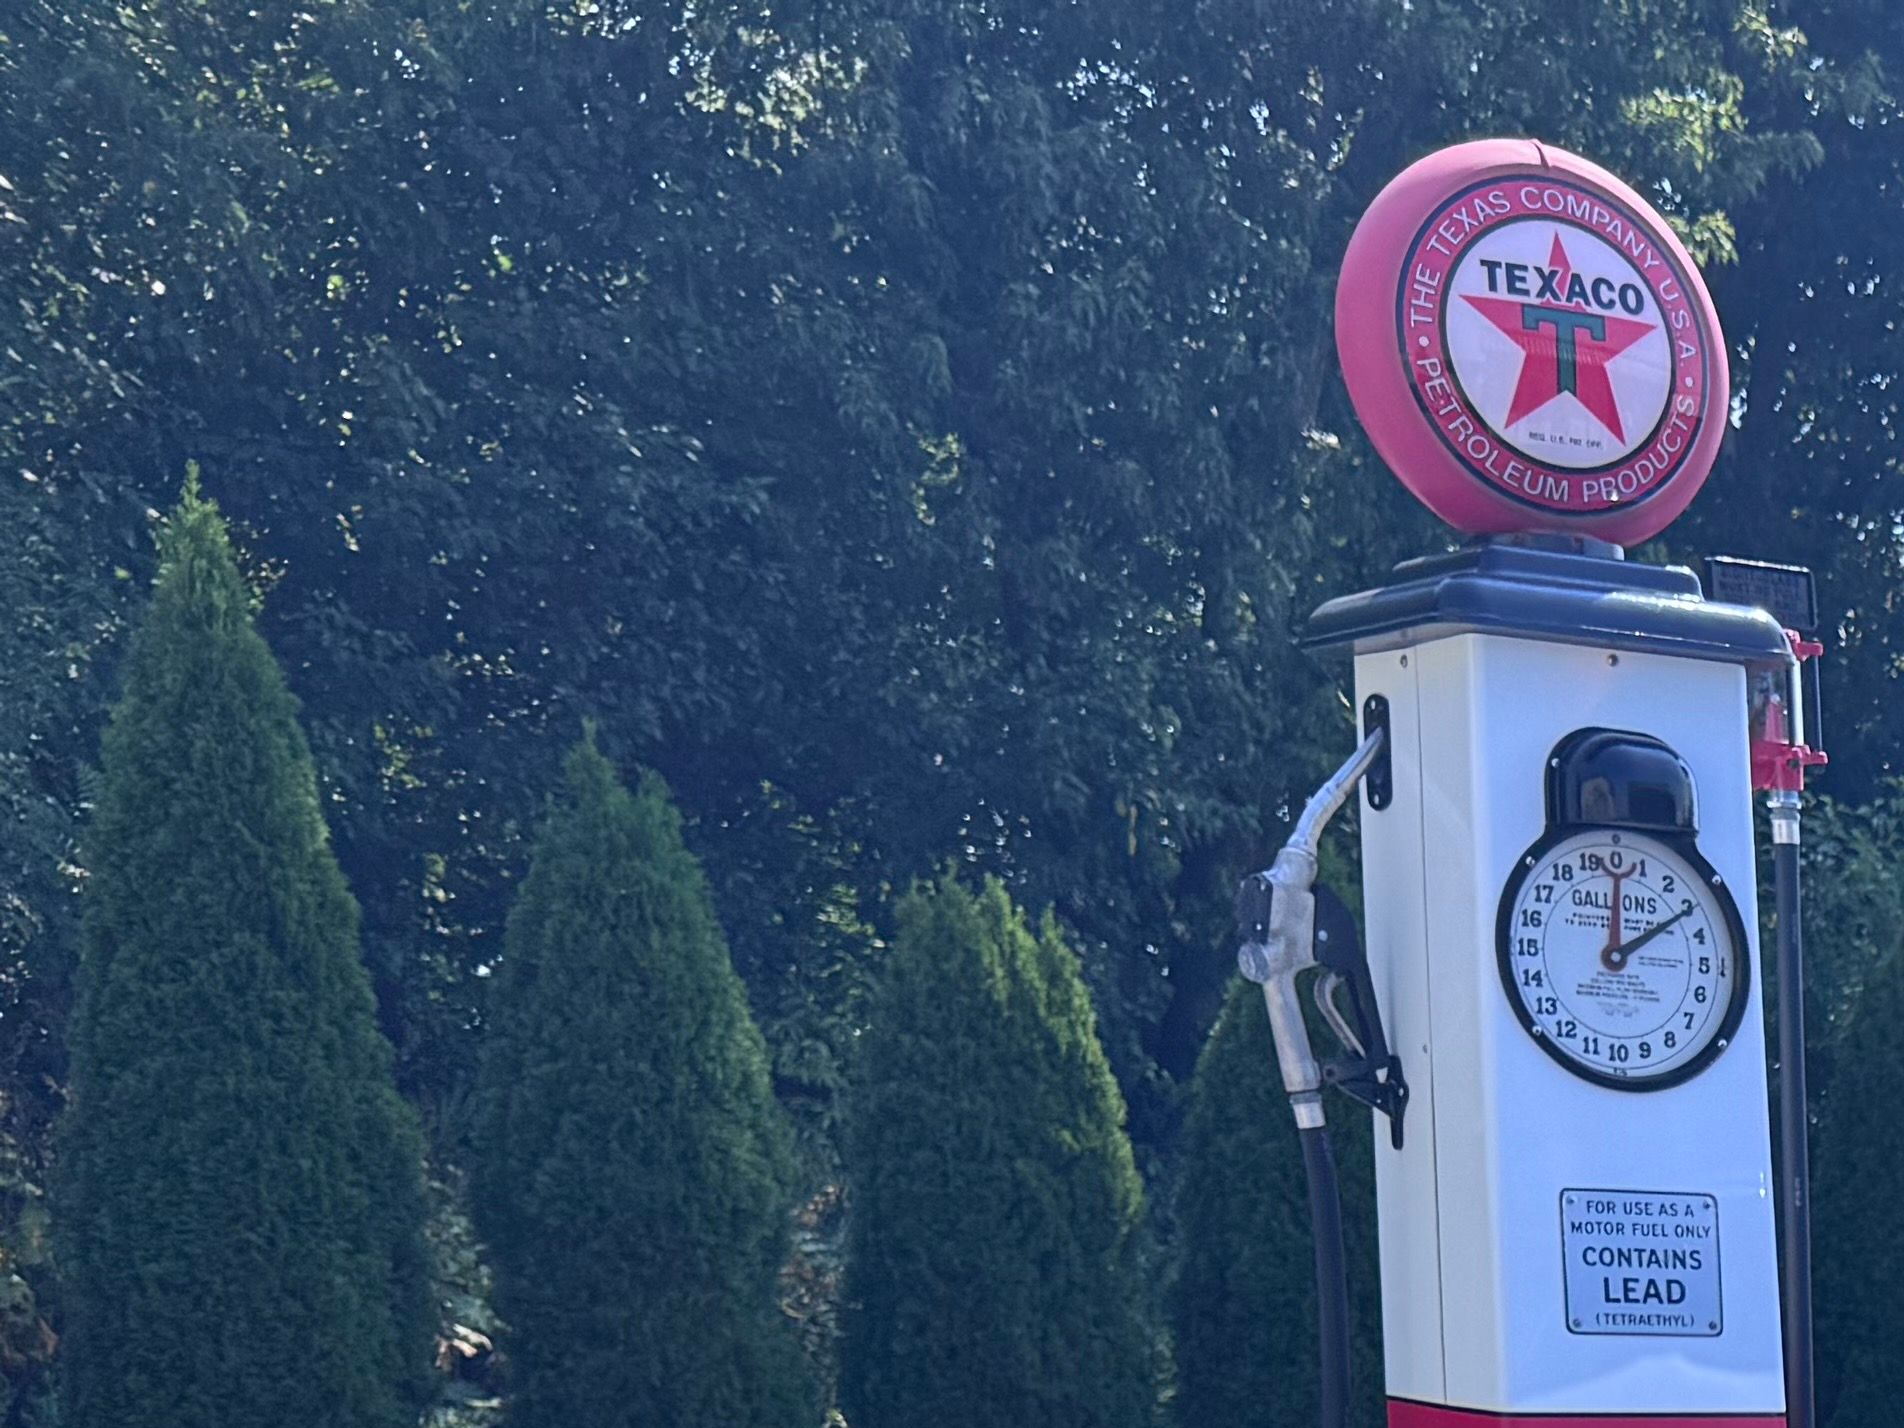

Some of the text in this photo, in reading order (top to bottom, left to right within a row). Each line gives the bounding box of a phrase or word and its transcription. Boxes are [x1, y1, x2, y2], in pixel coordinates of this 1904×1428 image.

[1410, 263, 1441, 328] THE
[1426, 191, 1511, 256] TEXAS
[1520, 186, 1660, 270] COMPANY
[1480, 258, 1645, 317] TEXACO
[1521, 303, 1606, 397] T
[1416, 357, 1696, 503] PETROLEUM PRODUCTS
[1579, 852, 1601, 872] 19
[1610, 850, 1623, 869] 0
[1639, 858, 1647, 878] 1
[1552, 863, 1574, 882] 18
[1662, 875, 1675, 893] 2
[1534, 884, 1554, 904] 17
[1572, 889, 1657, 914] GALLONS
[1521, 909, 1542, 928] 16
[1693, 927, 1705, 945] 4
[1518, 938, 1539, 957] 15
[1698, 957, 1710, 974] 5
[1523, 968, 1543, 987] 14
[1694, 986, 1707, 1003] 6
[1536, 996, 1557, 1015] 13
[1555, 1020, 1577, 1039] 12
[1683, 1012, 1695, 1030] 7
[1583, 1036, 1600, 1055] 11
[1664, 1031, 1676, 1048] 8
[1609, 1043, 1629, 1062] 10
[1639, 1042, 1651, 1059] 9
[1587, 1200, 1694, 1218] FOR USE AS A
[1571, 1221, 1711, 1239] MOTOR FUEL ONLY
[1582, 1246, 1702, 1271] CONTAINS
[1603, 1276, 1687, 1305] LEAD
